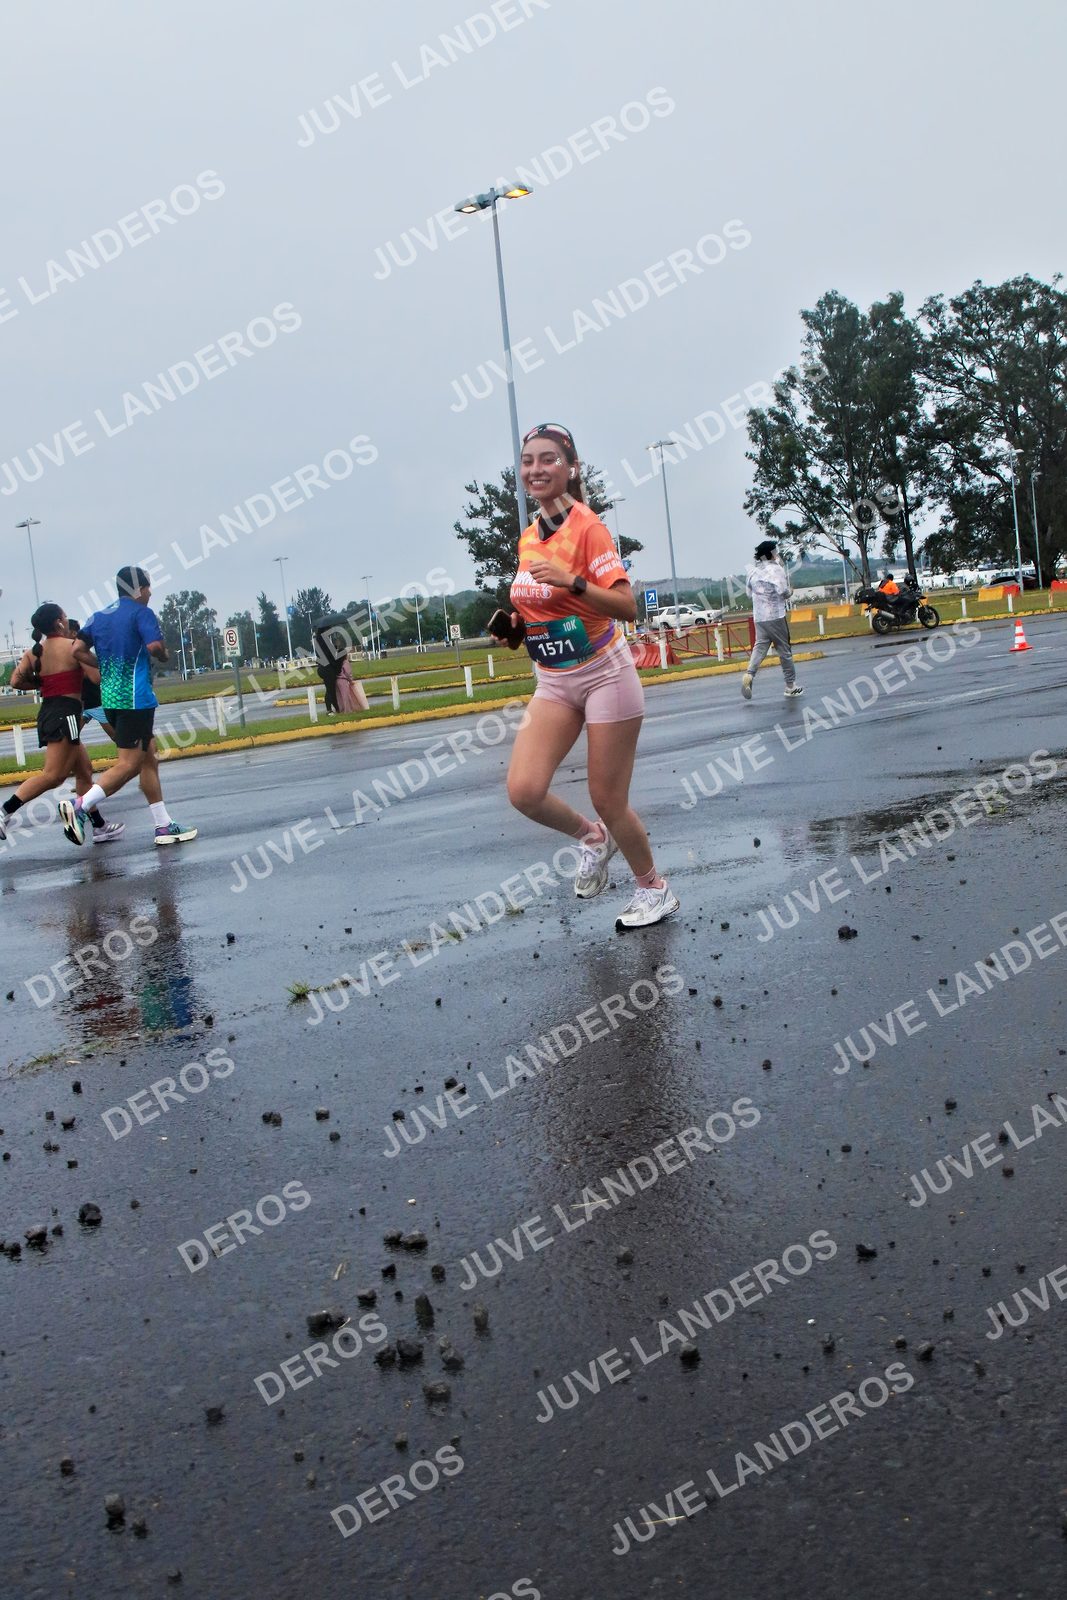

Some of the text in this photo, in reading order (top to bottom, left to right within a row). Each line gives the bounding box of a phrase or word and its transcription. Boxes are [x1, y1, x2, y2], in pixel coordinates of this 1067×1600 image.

[510, 587, 539, 598] MNILIFE
[563, 619, 577, 632] 10K
[538, 639, 575, 656] 1571
